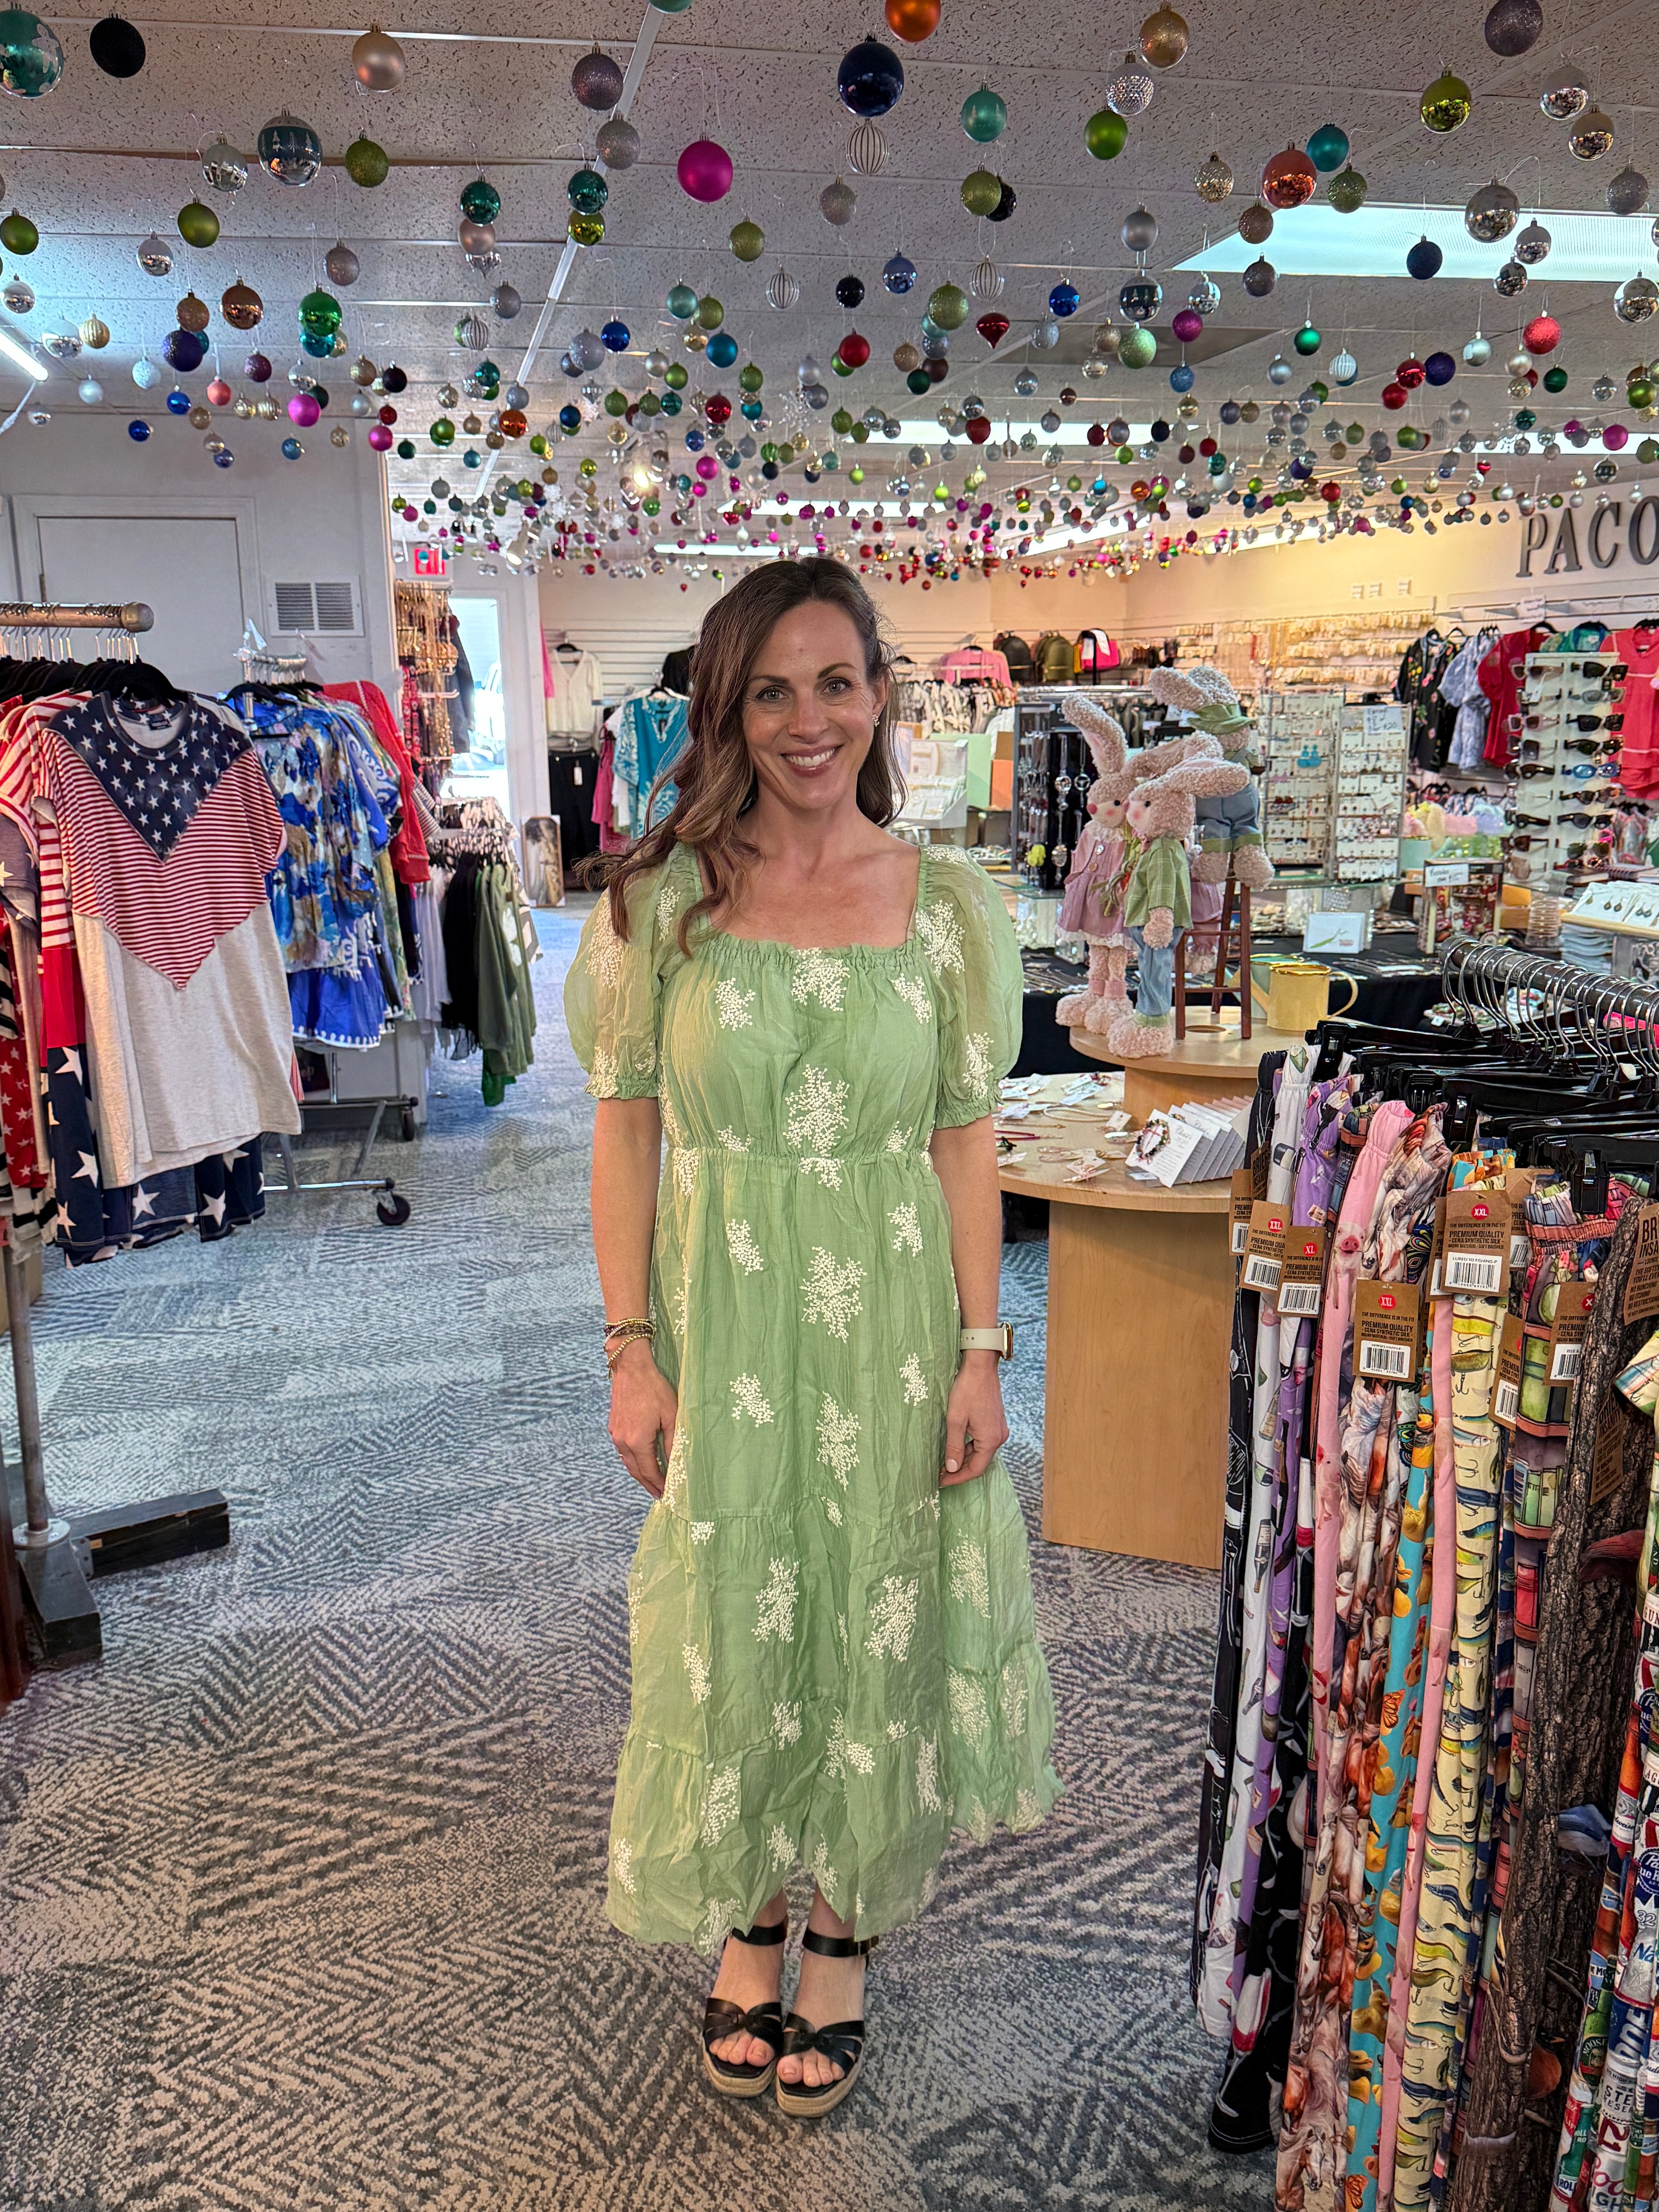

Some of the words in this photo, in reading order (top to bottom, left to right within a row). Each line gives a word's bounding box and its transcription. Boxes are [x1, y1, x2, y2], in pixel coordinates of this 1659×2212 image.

[1516, 496, 1659, 578] PACO
[1270, 1221, 1282, 1230] XXL
[1643, 1215, 1659, 1243] BR
[1251, 1237, 1274, 1246] PREMIUM
[1381, 1297, 1392, 1306] XXL
[1362, 1321, 1388, 1329] PREMIUM
[1390, 1324, 1413, 1332] QUALITY
[1637, 1910, 1656, 1926] 32
[1605, 2085, 1633, 2105] STE
